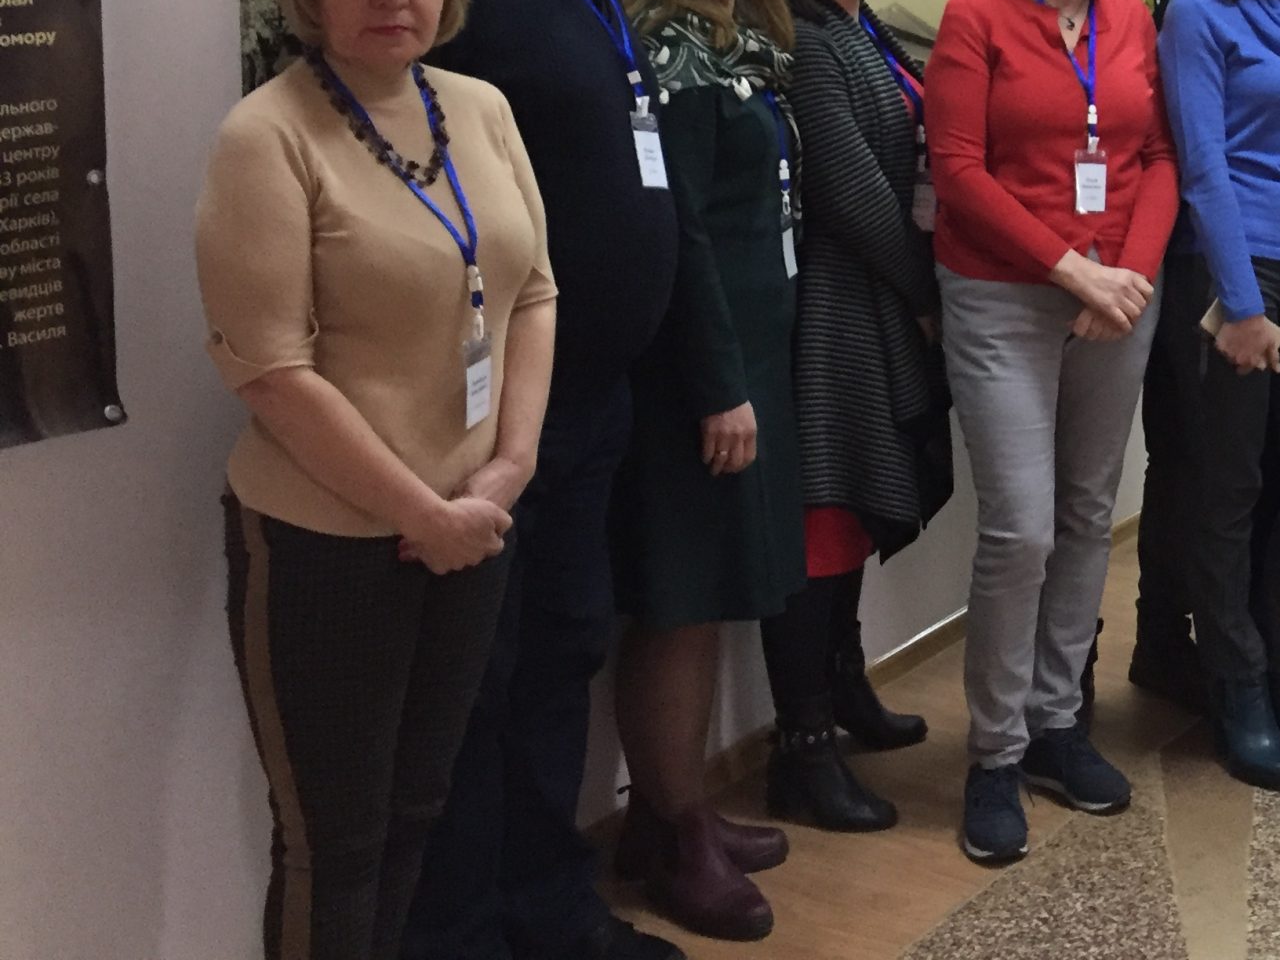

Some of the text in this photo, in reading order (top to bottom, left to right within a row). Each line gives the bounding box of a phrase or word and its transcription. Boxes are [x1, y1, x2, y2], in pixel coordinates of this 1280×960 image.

[3, 145, 60, 164] центру
[16, 166, 60, 187] років
[24, 190, 59, 207] села
[20, 256, 61, 276] міста
[14, 302, 64, 322] жертв
[8, 325, 66, 347] Василя
